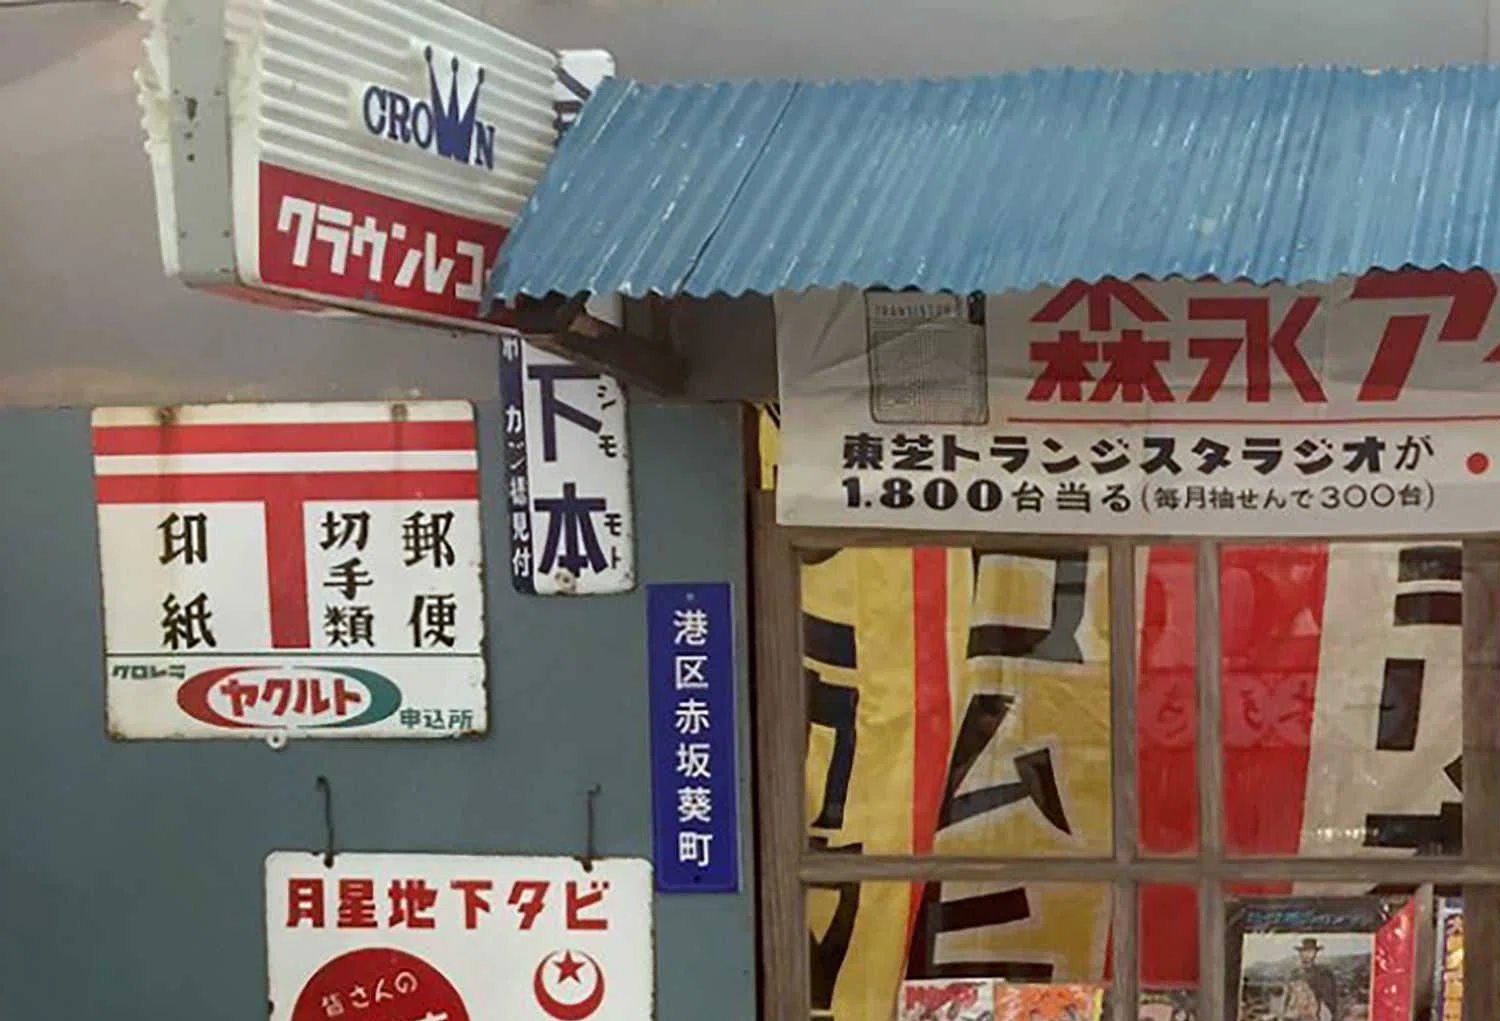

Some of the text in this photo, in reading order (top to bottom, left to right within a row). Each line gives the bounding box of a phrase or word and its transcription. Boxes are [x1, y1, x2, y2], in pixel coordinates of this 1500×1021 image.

[363, 46, 496, 170] CROWN
[277, 195, 492, 301] クラウンレコ
[842, 432, 1436, 475] 東芝トランジスタラジオが
[156, 511, 217, 650] 印紙
[318, 510, 376, 648] 切手類
[400, 510, 458, 649] 郵便
[219, 677, 363, 717] ヤクルト
[399, 707, 474, 731] 申込所
[672, 608, 713, 867] 港区赤坂葵町
[286, 877, 611, 930] 月星地下タビ
[320, 970, 419, 1018] 皆さんの
